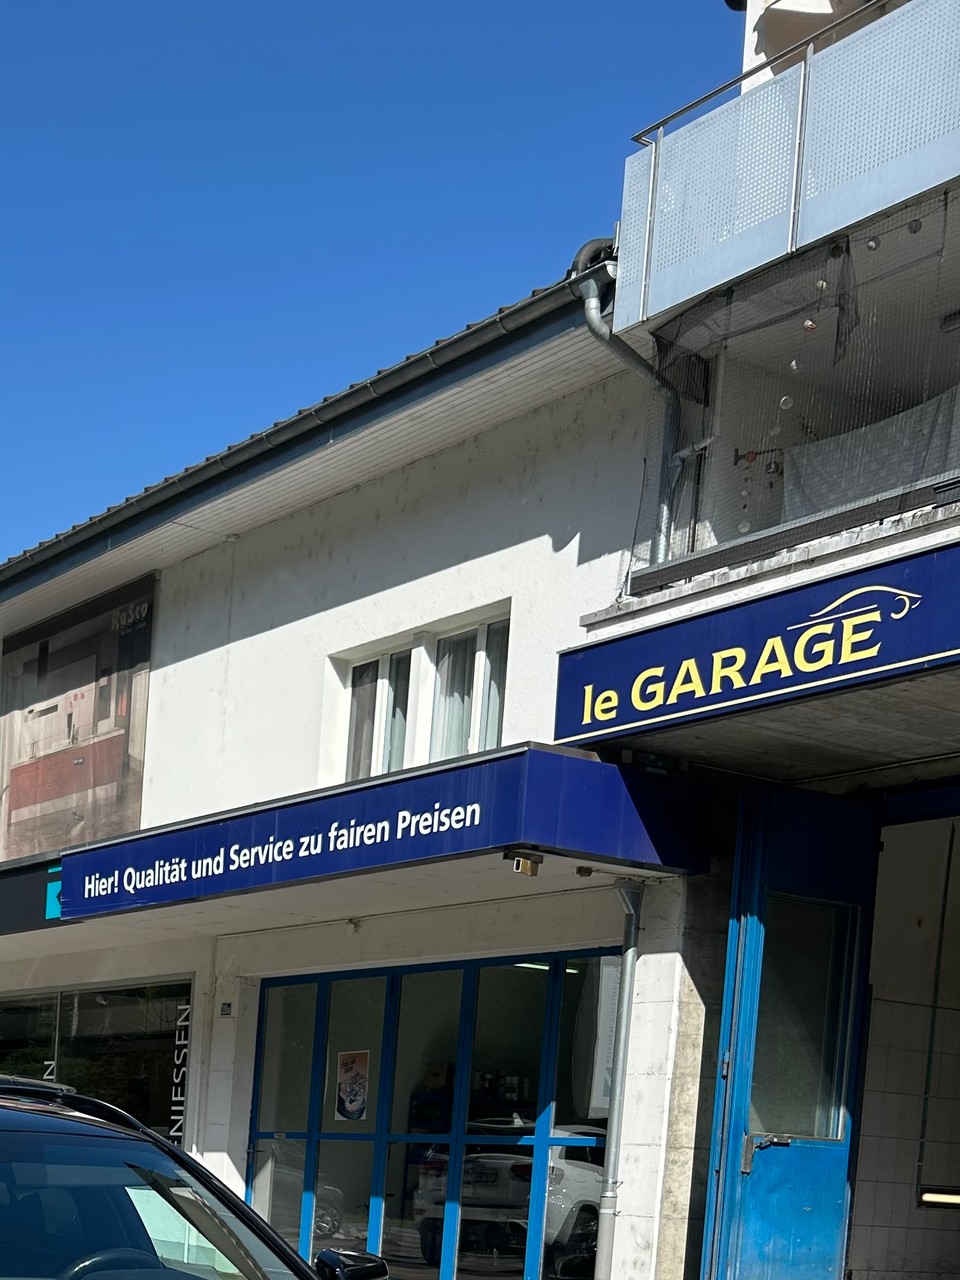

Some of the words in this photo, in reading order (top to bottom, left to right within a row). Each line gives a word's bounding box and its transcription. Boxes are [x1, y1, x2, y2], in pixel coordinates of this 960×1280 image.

[582, 685, 619, 724] le
[630, 611, 882, 710] GARAGE
[84, 870, 119, 898] Hier!
[123, 857, 188, 894] Qualität
[191, 847, 225, 880] und
[229, 836, 294, 871] Service
[298, 833, 323, 858] zu
[327, 819, 390, 852] fairen
[396, 802, 481, 840] Preisen
